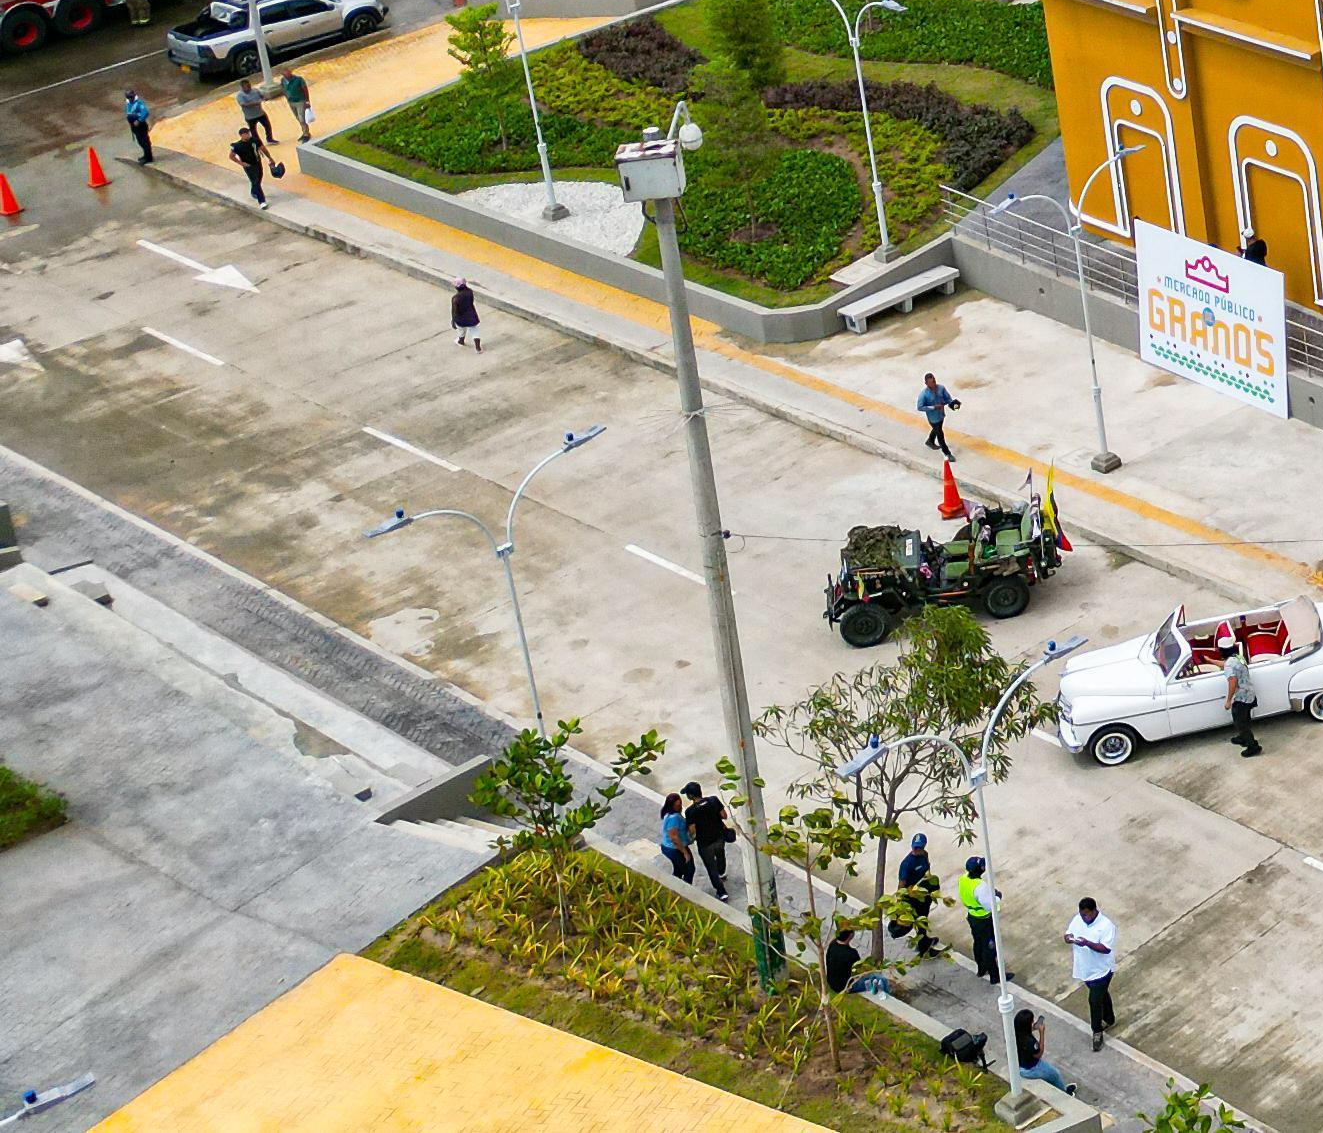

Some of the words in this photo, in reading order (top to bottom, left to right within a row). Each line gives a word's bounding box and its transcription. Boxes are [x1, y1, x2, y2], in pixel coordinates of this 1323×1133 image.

[1148, 288, 1275, 377] GRANOS
[1164, 276, 1210, 304] MERCADO
[1214, 294, 1256, 322] PÚBLICO
